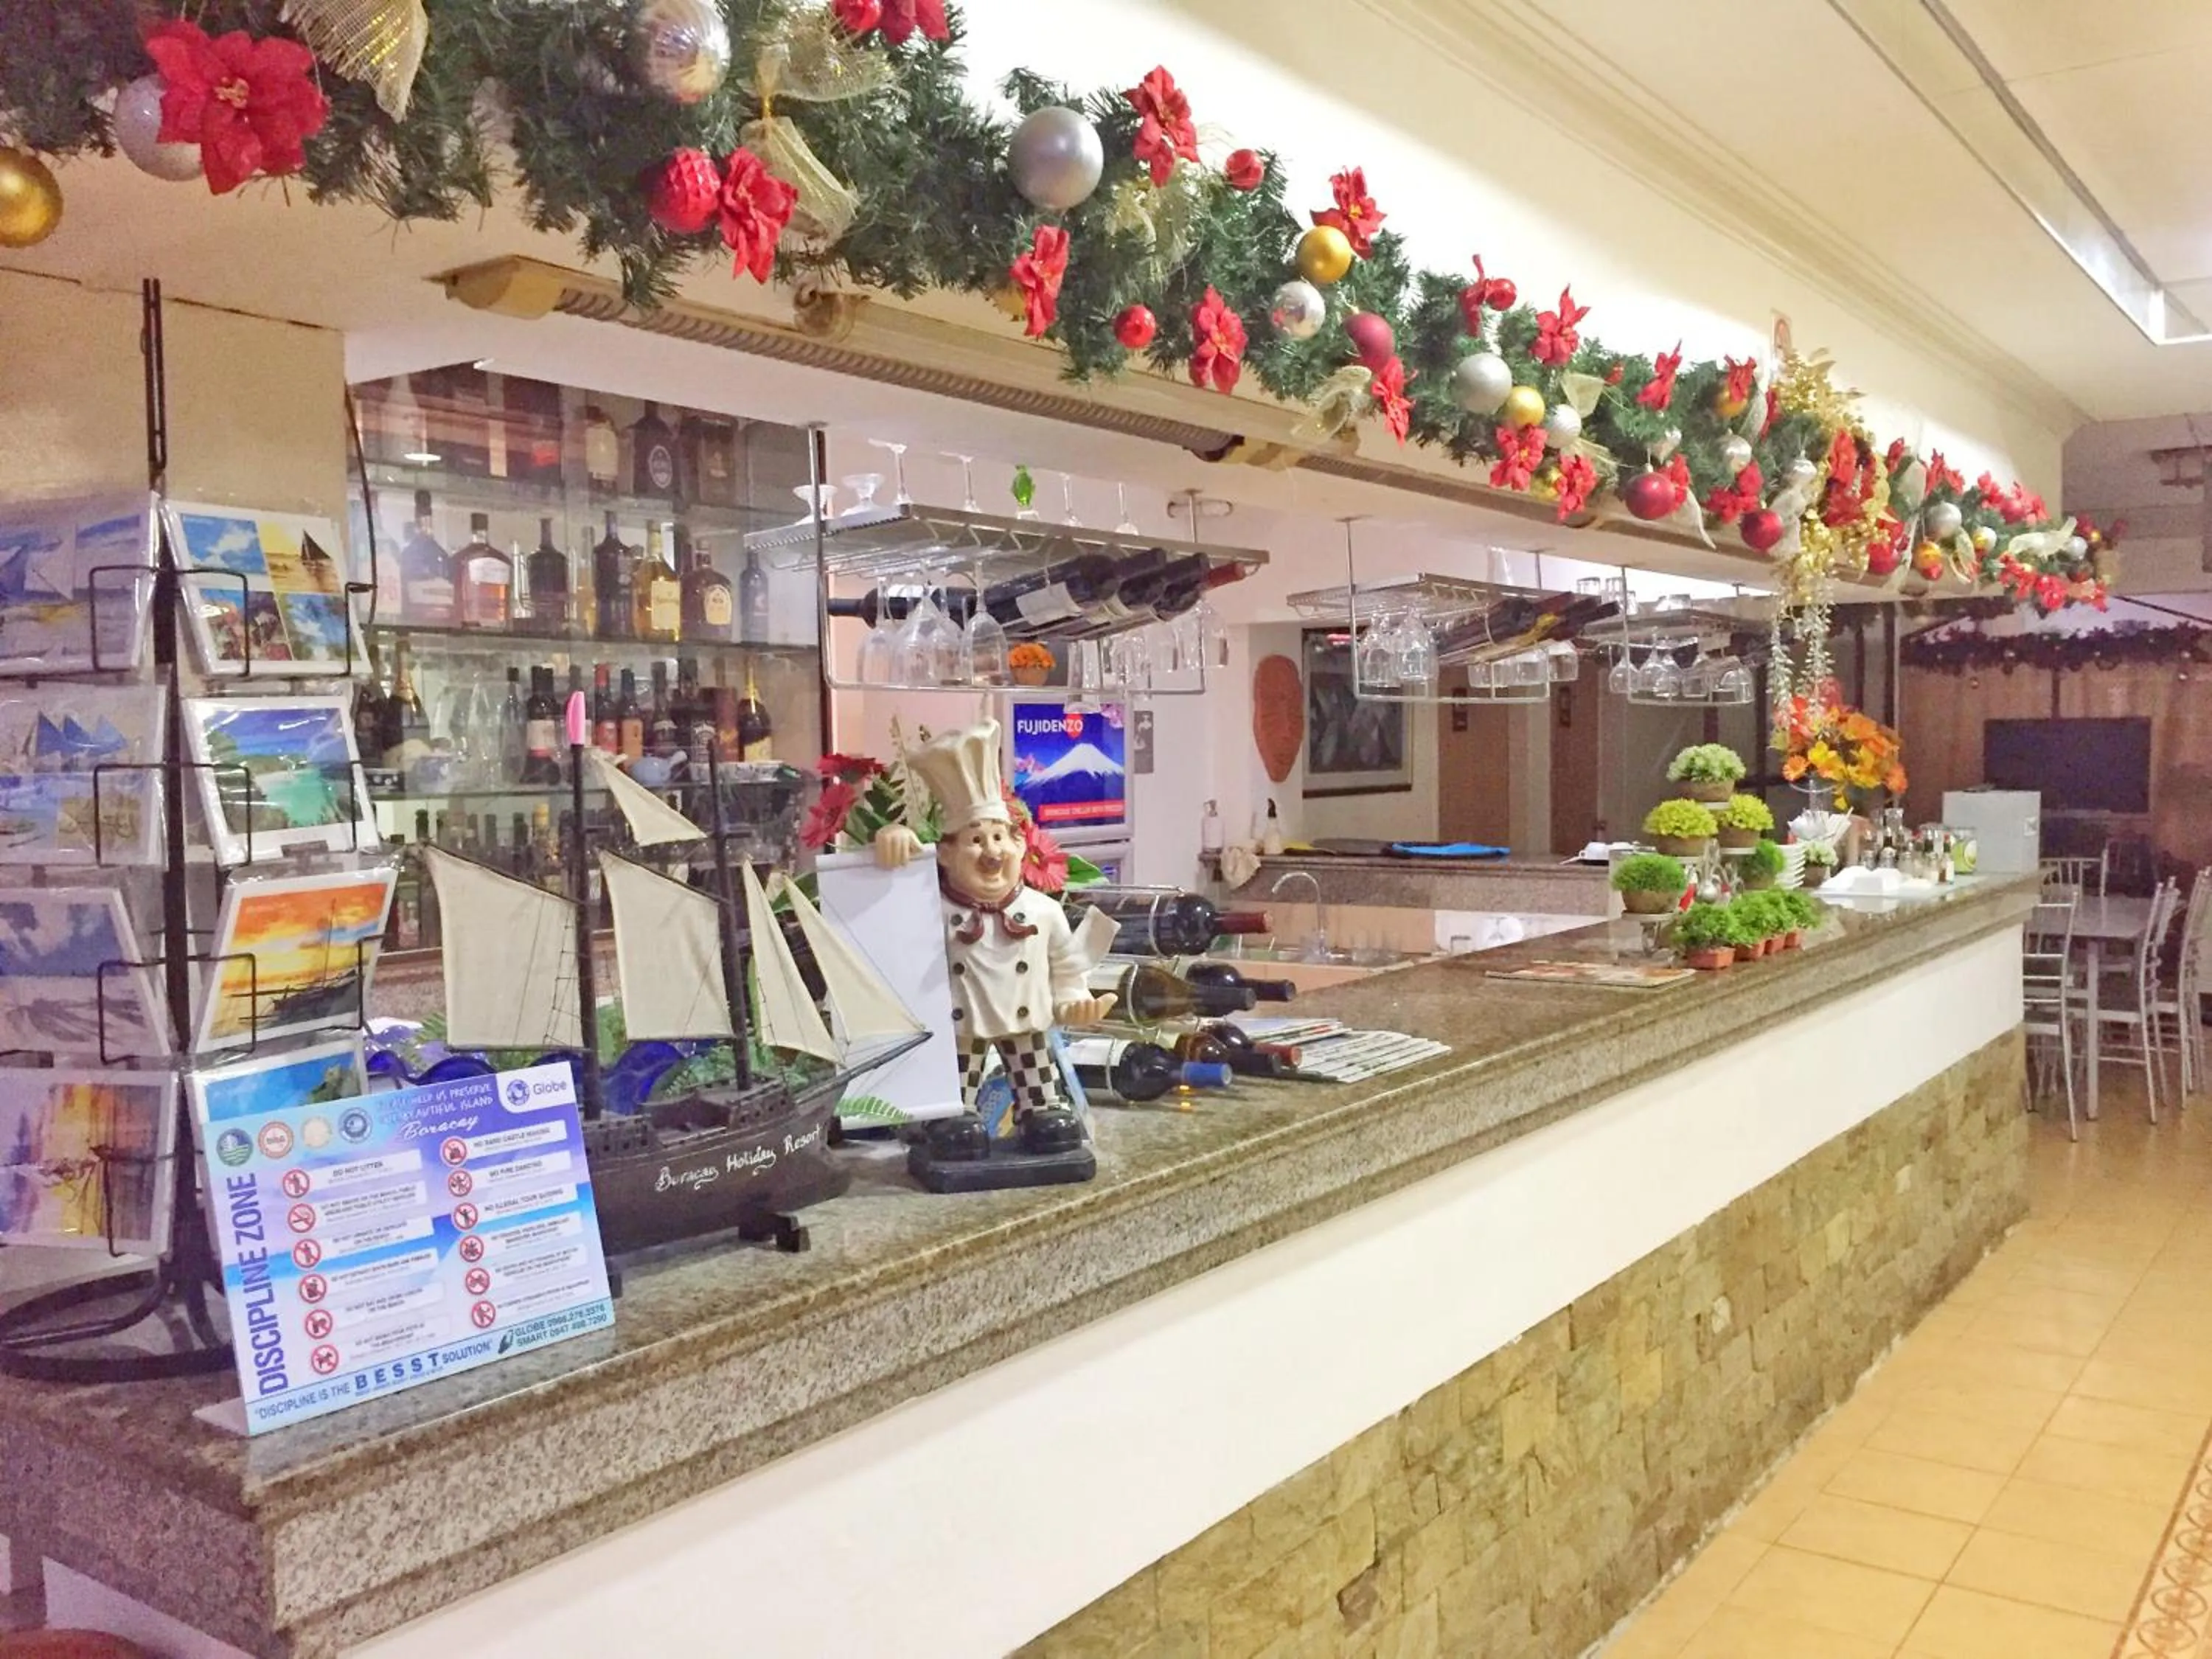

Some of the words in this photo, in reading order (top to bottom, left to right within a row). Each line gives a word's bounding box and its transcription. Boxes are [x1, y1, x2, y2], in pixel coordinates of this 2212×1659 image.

[1017, 719, 1083, 734] FUJIDENZO
[449, 1082, 493, 1098] PRESERVE
[532, 1079, 567, 1096] Globe
[460, 1096, 494, 1111] ISLAND
[400, 1113, 479, 1140] Boracay
[726, 1145, 776, 1176] Holiday
[783, 1123, 822, 1156] Resort
[344, 1166, 359, 1174] NOT
[226, 1172, 265, 1245] ZONE
[238, 1246, 289, 1396] DISCIPLINE
[515, 1321, 545, 1337] GLOBE
[516, 1330, 548, 1346] SMART
[319, 1388, 329, 1401] IS
[330, 1381, 351, 1398] THE
